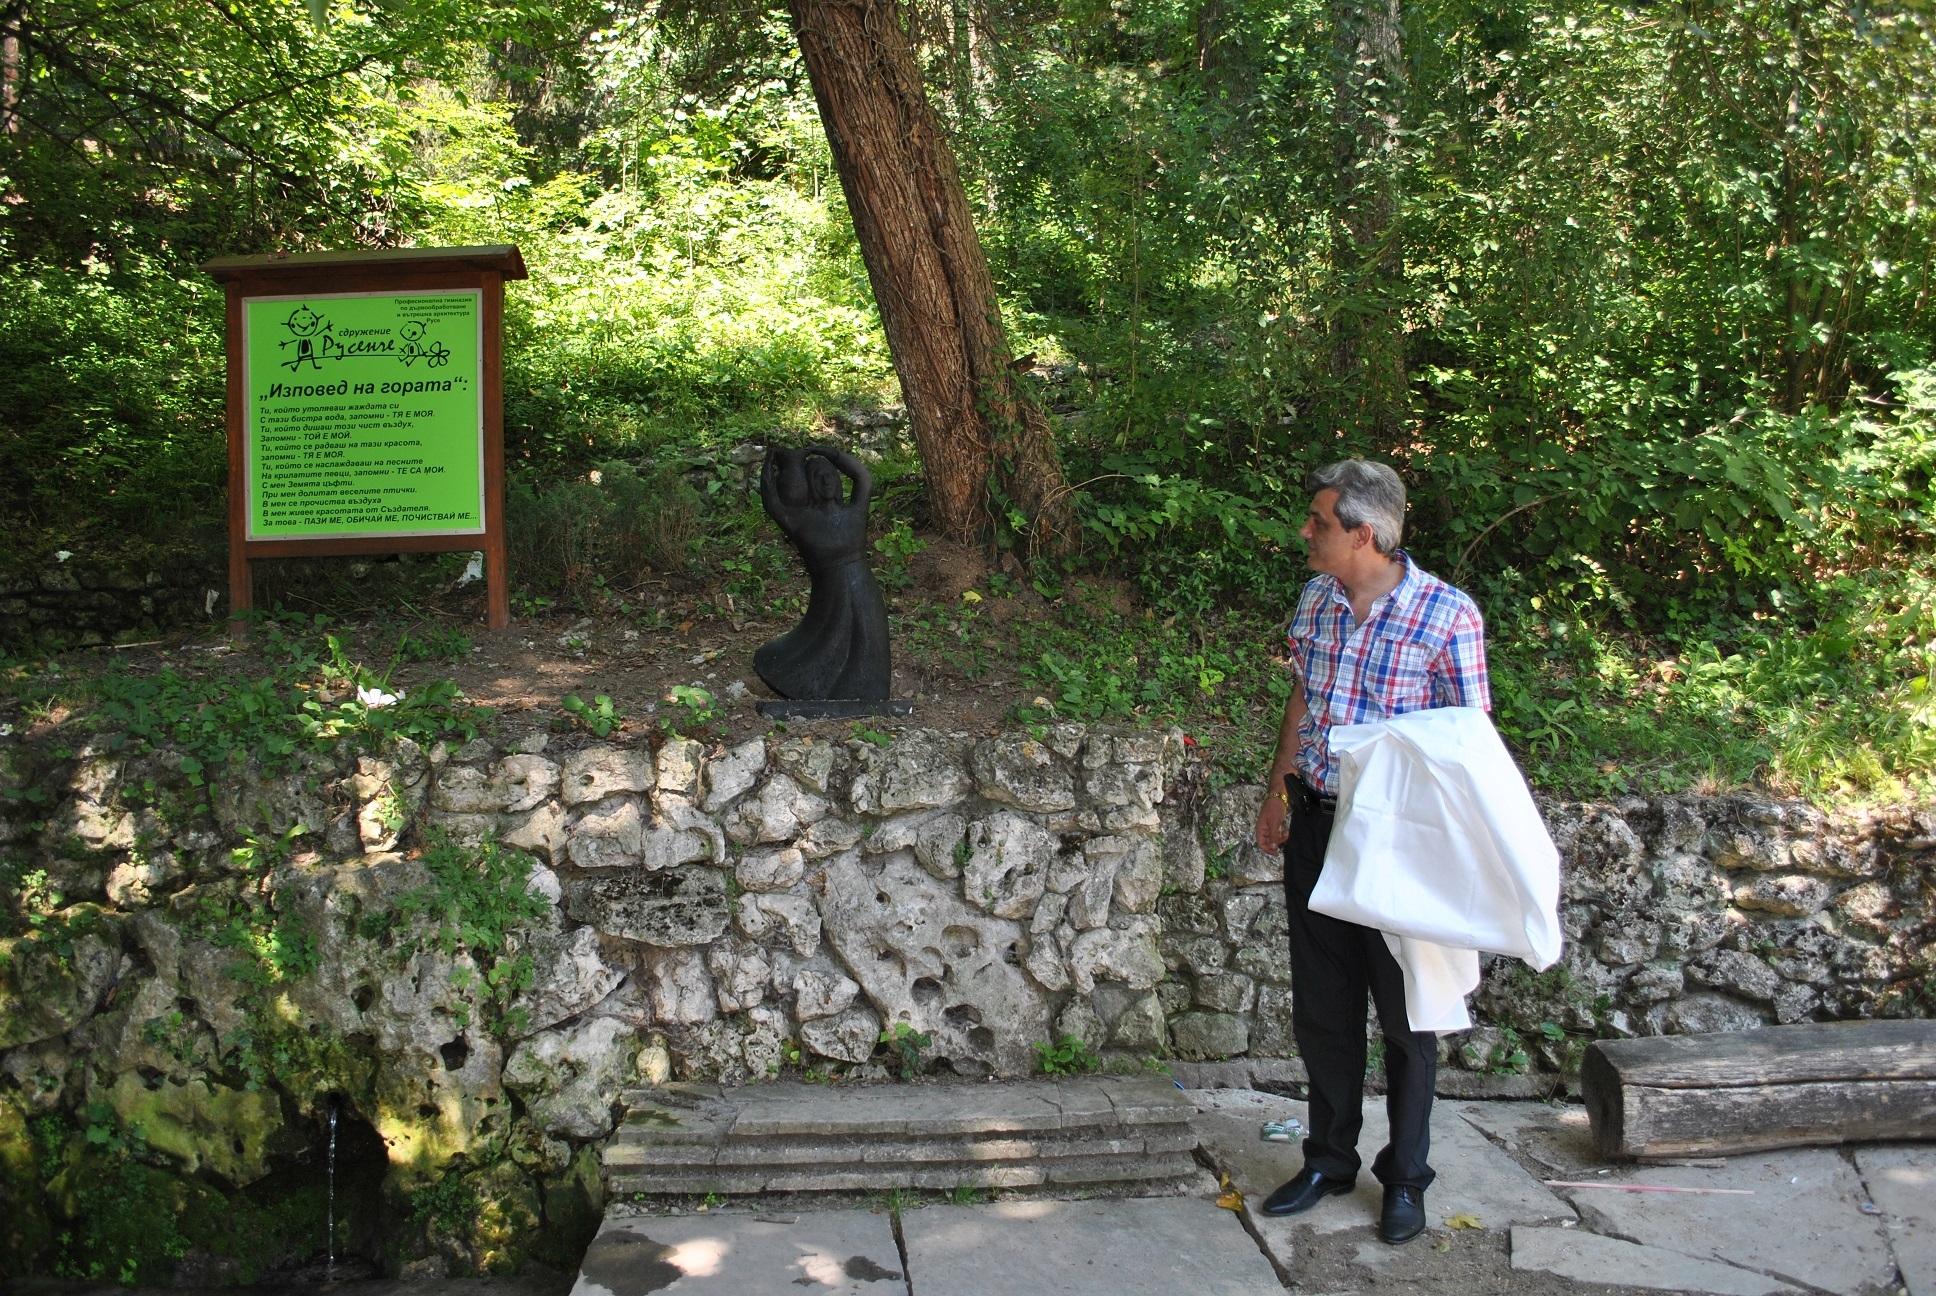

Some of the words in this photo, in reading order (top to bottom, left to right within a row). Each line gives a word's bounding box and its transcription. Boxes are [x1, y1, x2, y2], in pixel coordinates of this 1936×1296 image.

[338, 328, 391, 338] сдружение
[322, 335, 395, 360] Русенче
[354, 384, 375, 394] на
[260, 407, 272, 415] Ти,
[274, 405, 300, 413] който
[302, 404, 346, 413] утоляваш
[348, 402, 387, 410] жаждата
[292, 414, 322, 423] бистра
[325, 413, 347, 421] вода,
[303, 423, 332, 431] дишаш
[383, 420, 413, 429] въздух,
[304, 432, 320, 441] ТОЙ
[315, 442, 346, 450] радваш
[384, 440, 422, 448] красота,
[275, 461, 302, 470] който
[316, 460, 372, 468] наслаждаваш
[274, 471, 322, 479] крилатите
[340, 487, 381, 495] веселите
[300, 498, 346, 507] прочиства
[348, 497, 381, 505] въздуха
[316, 507, 364, 516] красотата
[329, 516, 343, 524] МЕ,
[346, 514, 382, 524] ОБИЧАЙ
[385, 514, 399, 522] МЕ,
[402, 512, 455, 522] ПОЧИСТВАЙ
